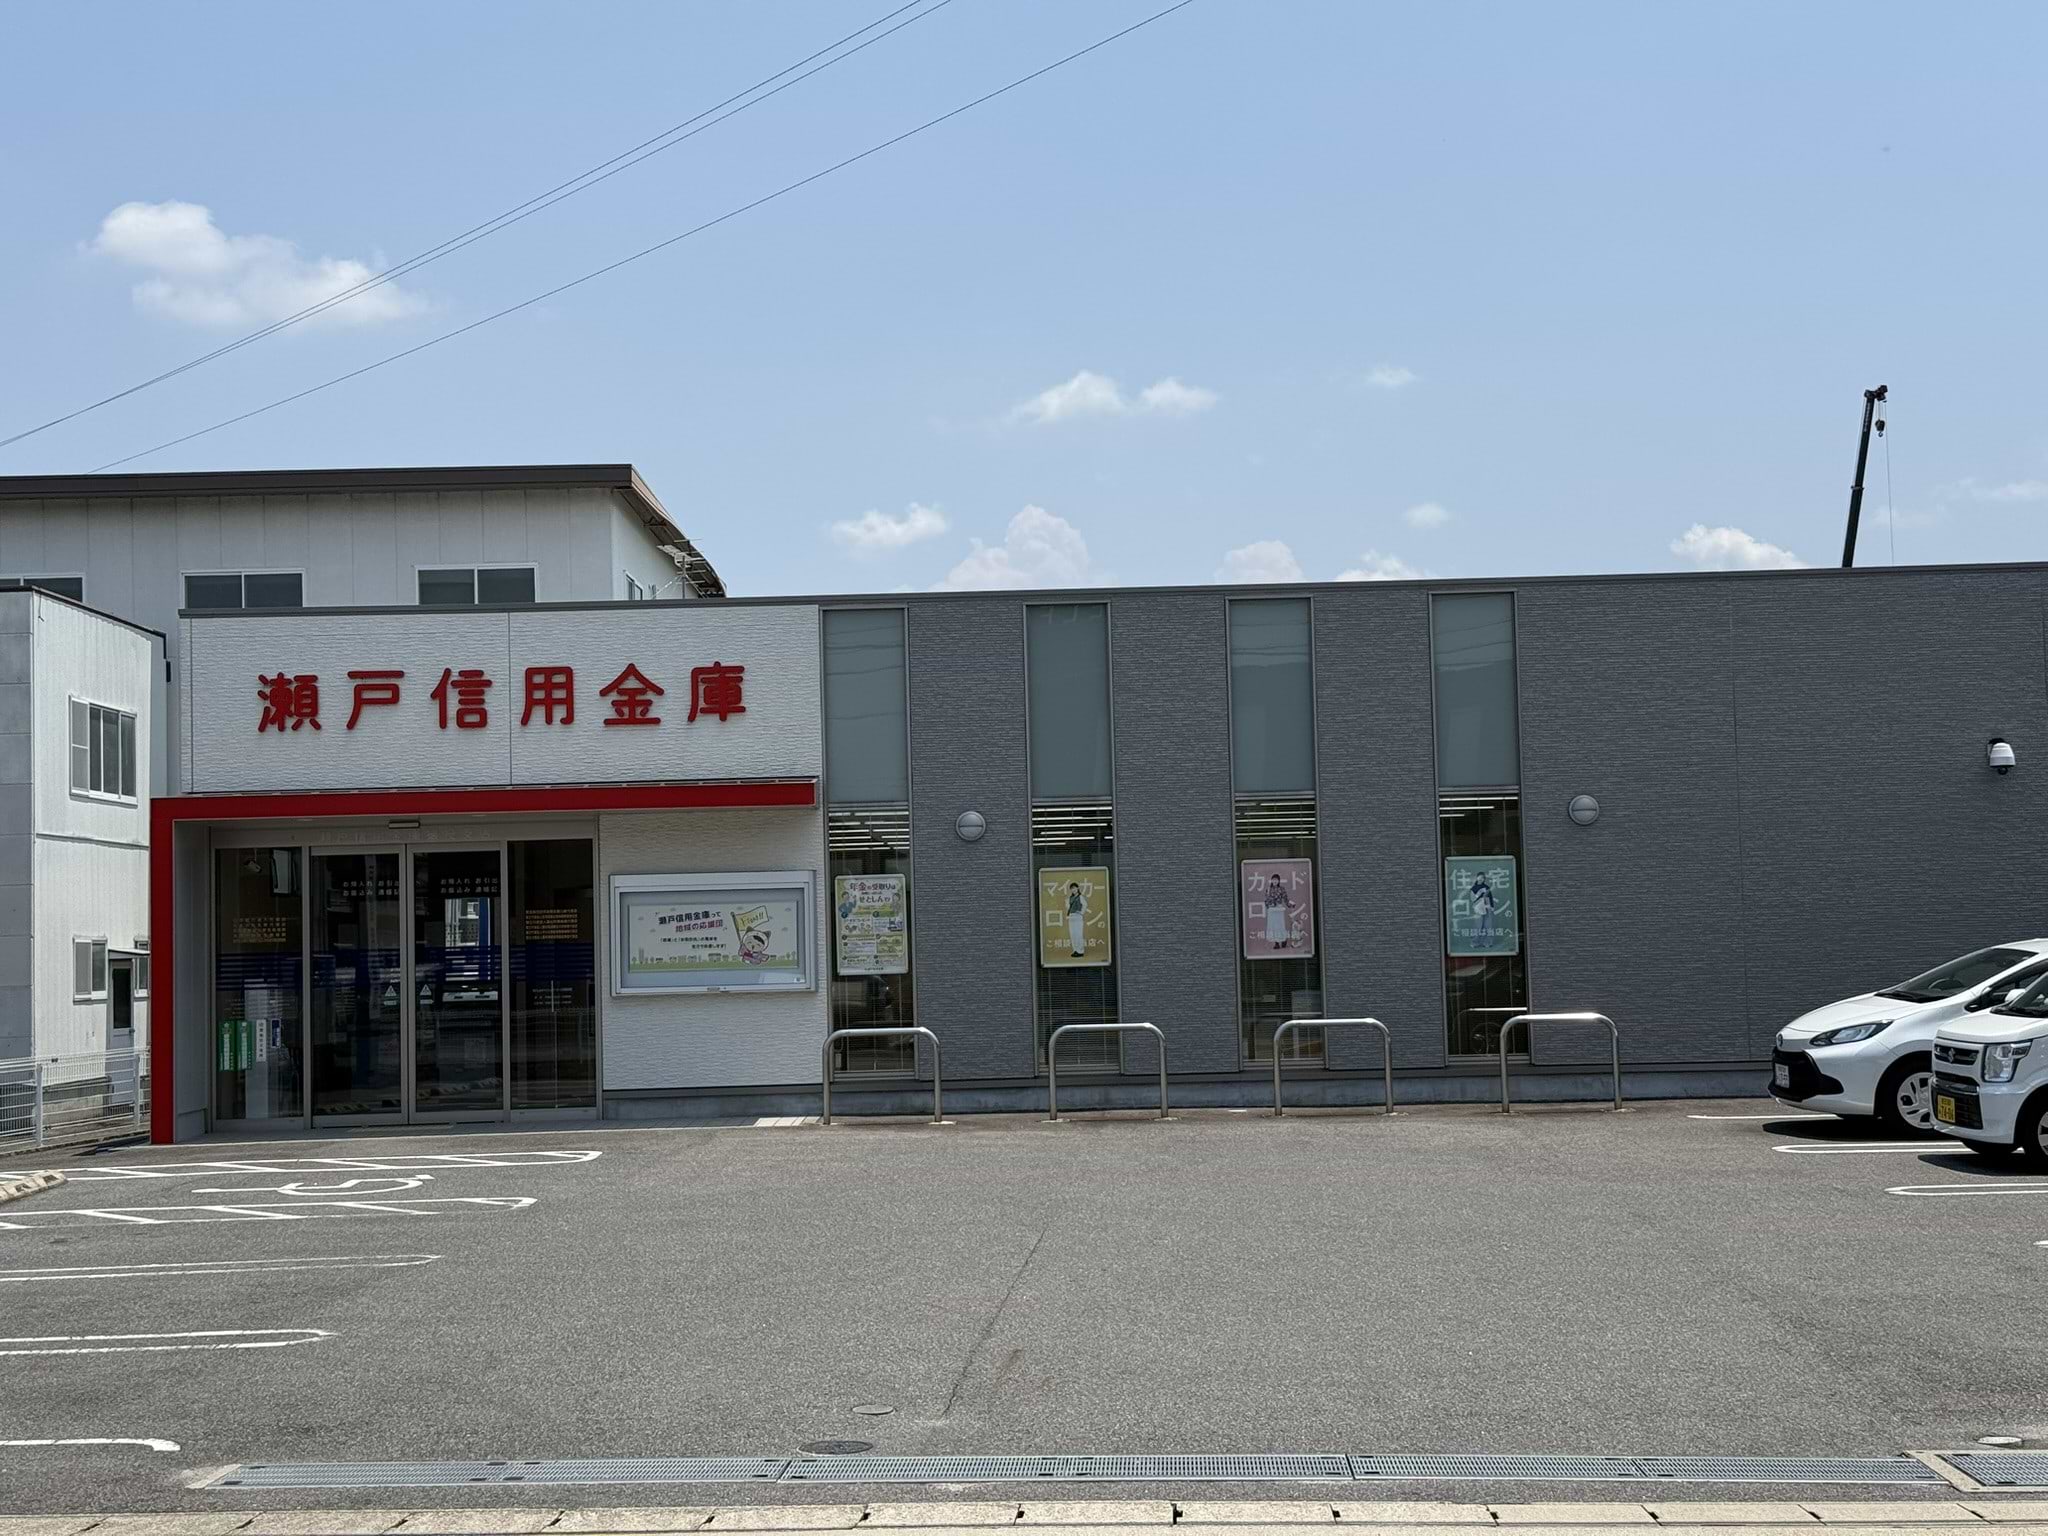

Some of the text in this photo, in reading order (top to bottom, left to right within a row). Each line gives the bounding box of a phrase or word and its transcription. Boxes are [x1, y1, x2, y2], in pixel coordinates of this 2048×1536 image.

[258, 661, 745, 732] 瀬戸信用金庫
[1043, 878, 1106, 897] マイカー
[1247, 871, 1308, 892] カード
[1450, 867, 1510, 890] 住宅
[658, 910, 722, 925] 瀬戸信用金庫って
[675, 919, 723, 933] 地域の応援団
